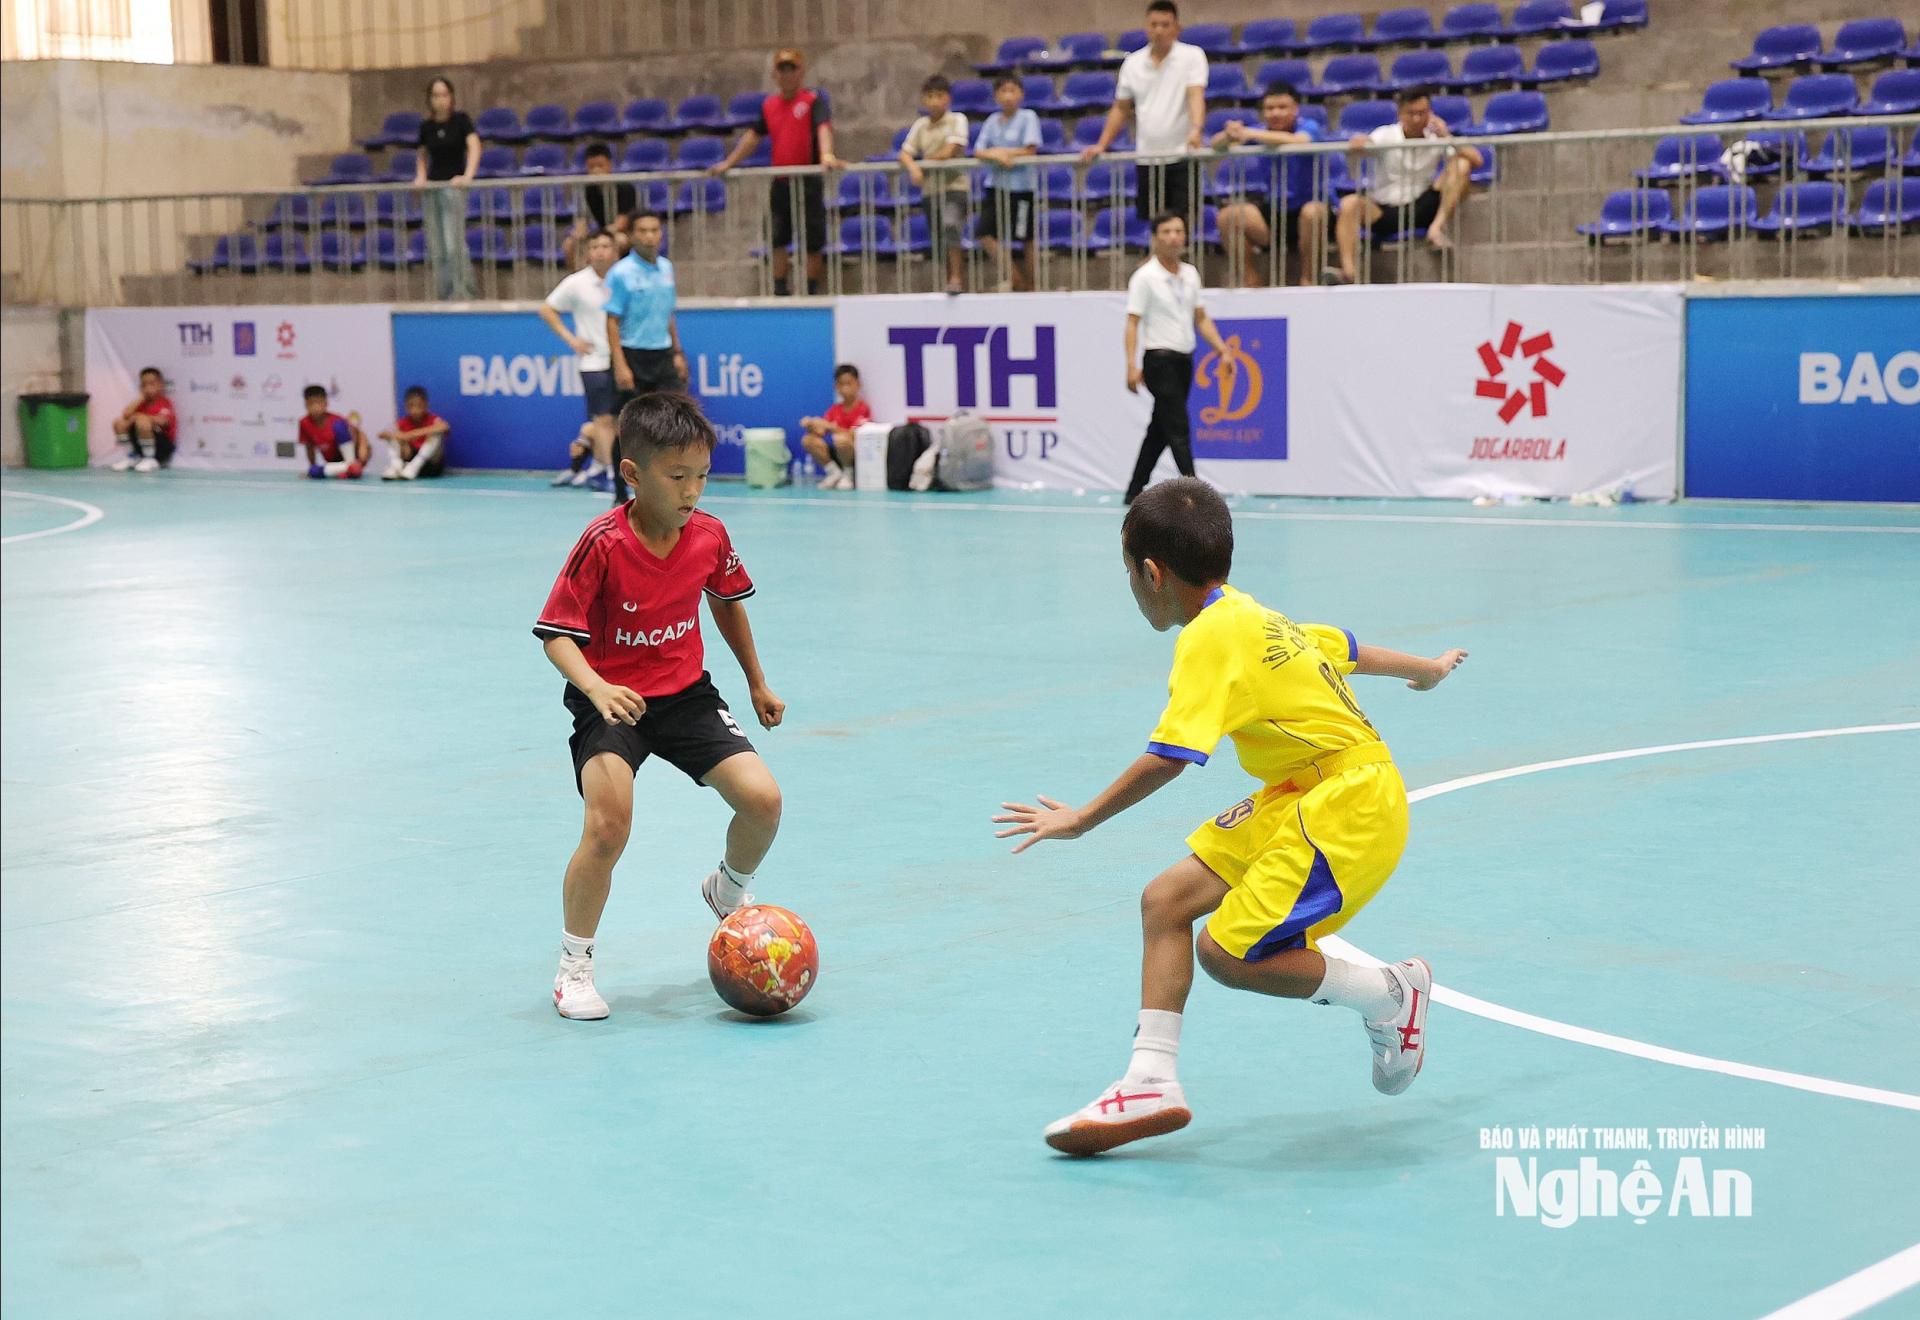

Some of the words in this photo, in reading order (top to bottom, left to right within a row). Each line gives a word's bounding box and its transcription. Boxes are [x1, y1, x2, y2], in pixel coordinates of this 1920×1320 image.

[178, 323, 213, 343] TTH
[698, 353, 764, 398] Life
[888, 326, 1057, 408] TTH
[1468, 437, 1567, 460] JOCARBOLA
